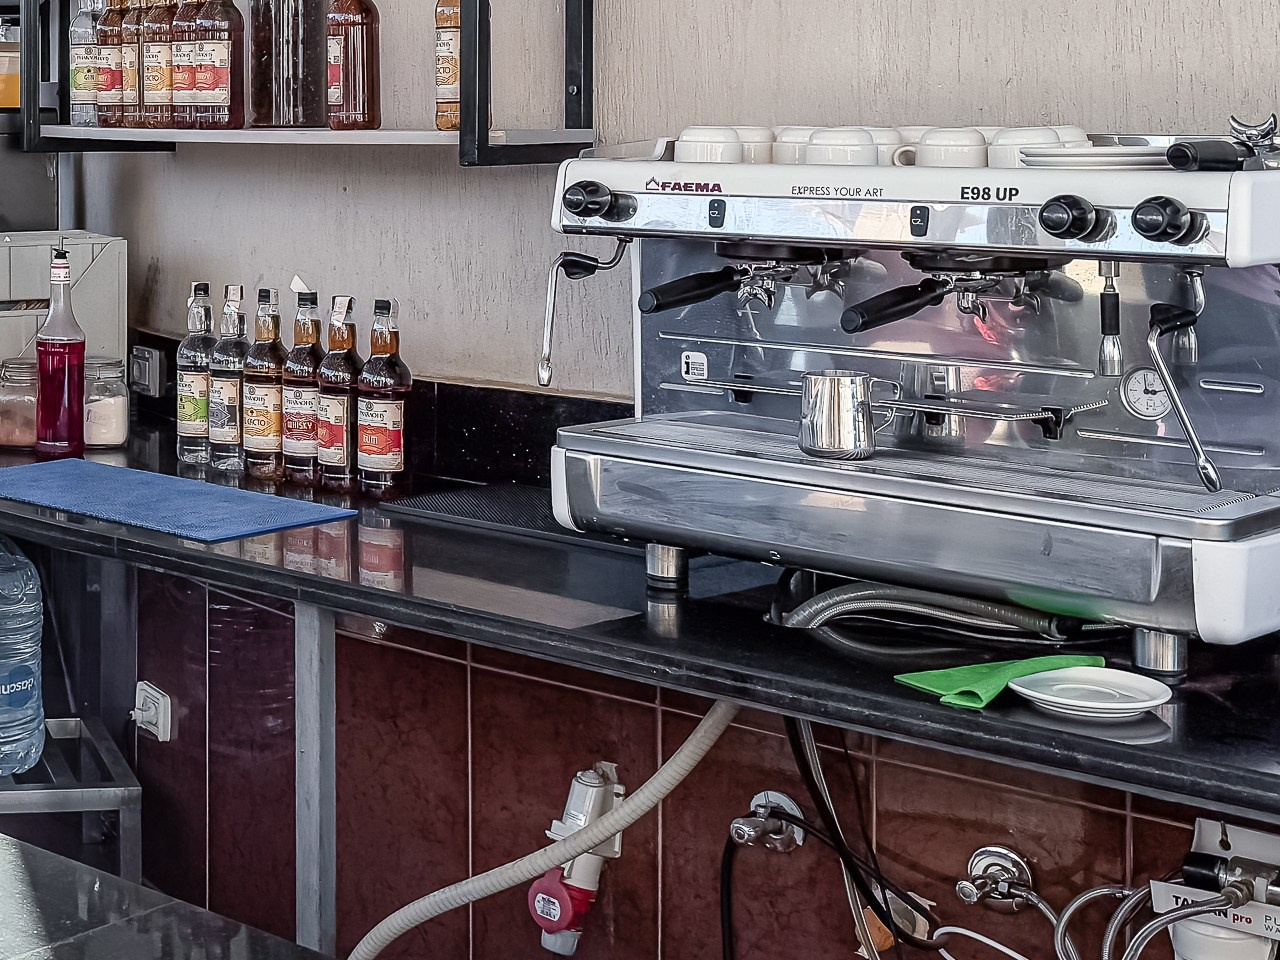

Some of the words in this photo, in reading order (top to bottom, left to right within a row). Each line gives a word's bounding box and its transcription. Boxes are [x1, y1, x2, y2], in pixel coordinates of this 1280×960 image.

[660, 181, 723, 194] FAEMA
[791, 185, 831, 196] EXPRESS
[834, 186, 862, 197] YOUR
[864, 188, 884, 198] ART
[960, 186, 992, 201] E98
[995, 187, 1020, 202] UP
[287, 421, 313, 430] WHISKY
[1232, 913, 1253, 925] pro
